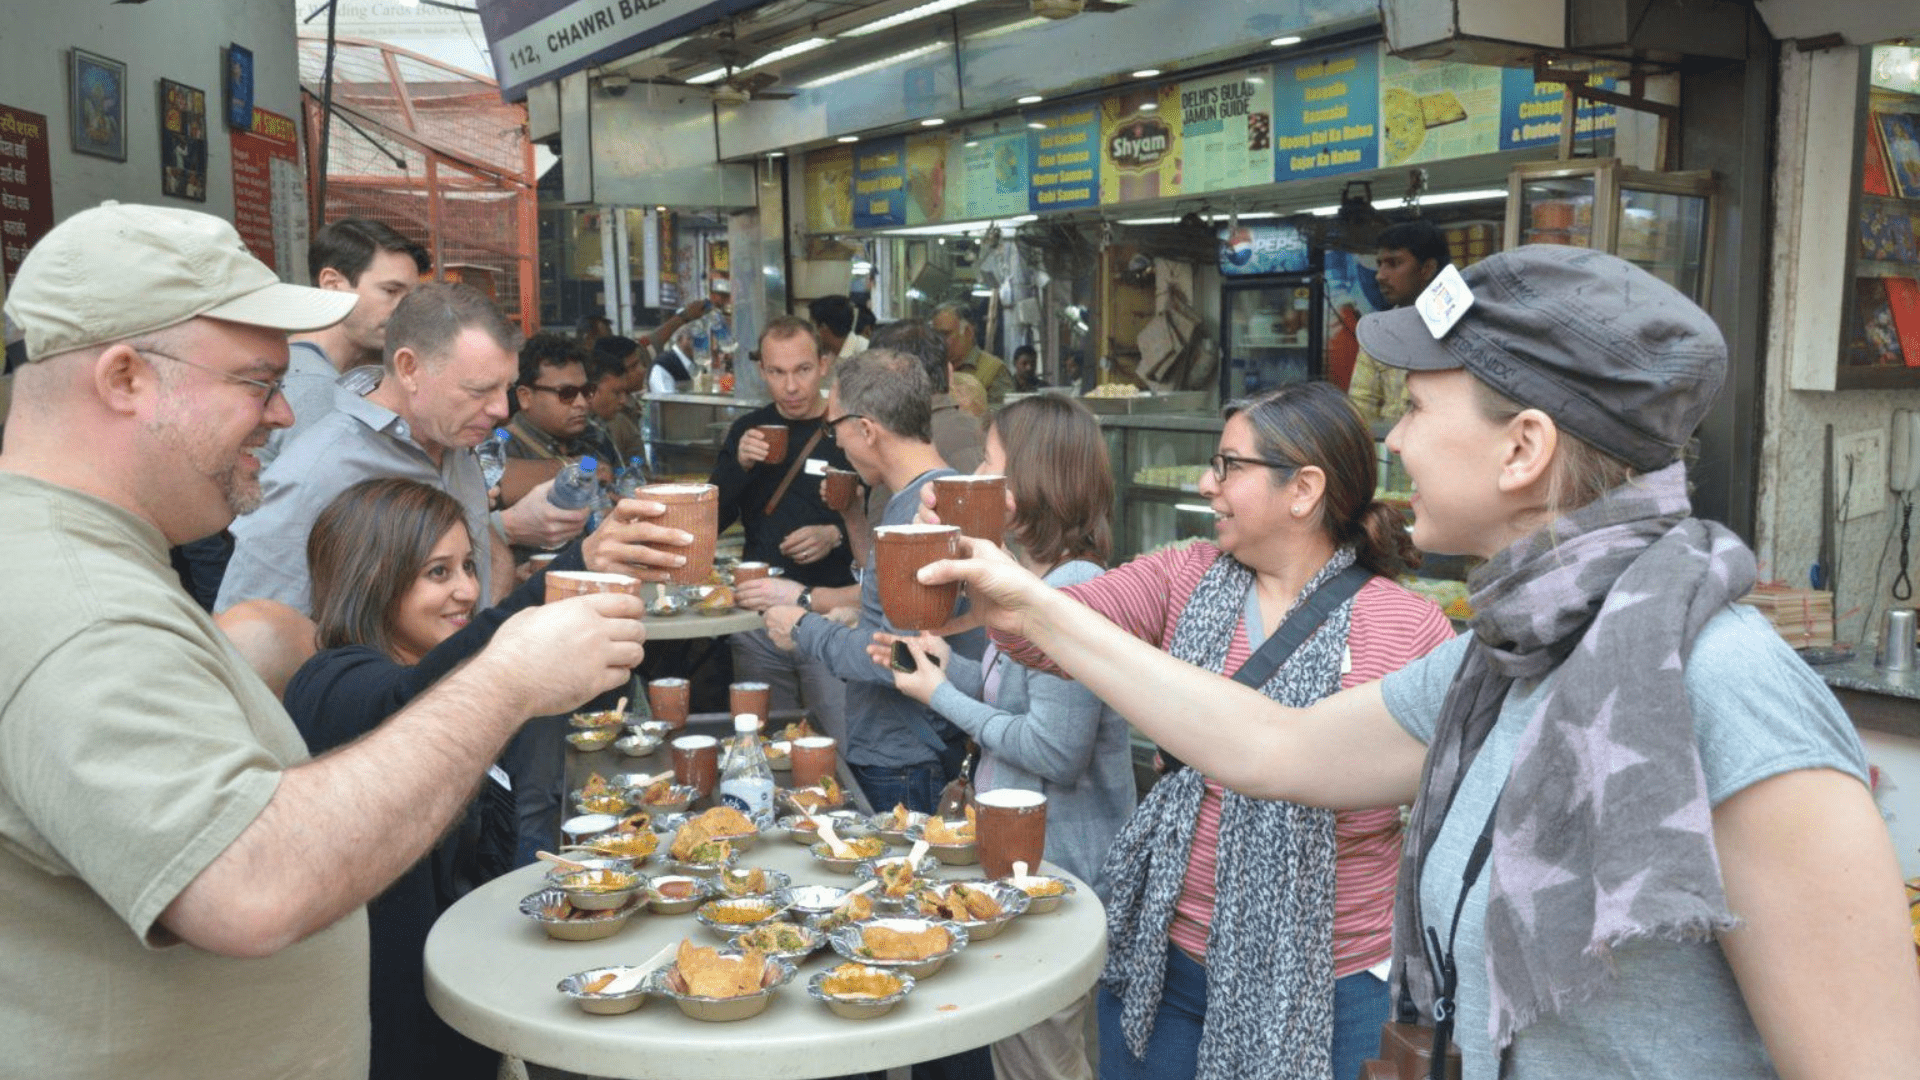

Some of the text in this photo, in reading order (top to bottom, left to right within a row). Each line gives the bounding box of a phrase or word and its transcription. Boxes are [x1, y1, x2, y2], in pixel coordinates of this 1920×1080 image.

[371, 3, 411, 17] Cards
[509, 0, 667, 70] 112, CHAWRI BAZ
[1182, 81, 1255, 109] DELHI'S GULAB
[1183, 98, 1250, 125] JAMUN GUIDE
[1113, 135, 1166, 158] Shyam
